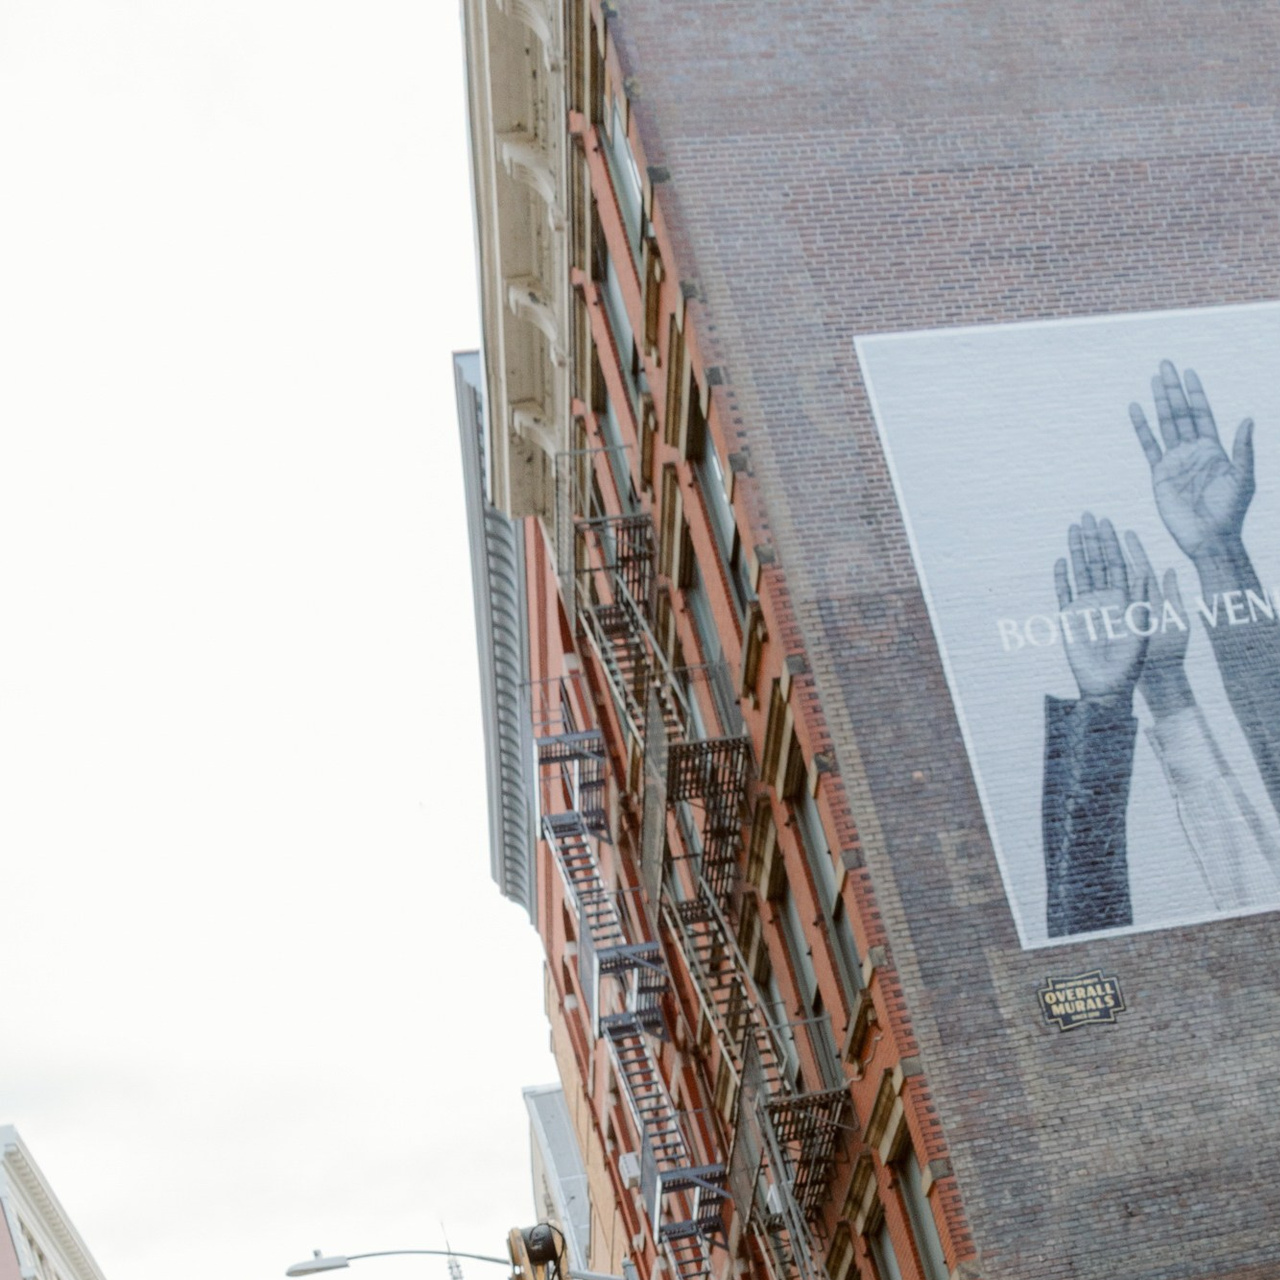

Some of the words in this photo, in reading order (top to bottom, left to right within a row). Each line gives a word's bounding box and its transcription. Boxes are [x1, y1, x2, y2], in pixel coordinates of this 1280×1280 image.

[997, 600, 1187, 652] BOTTEGA
[1044, 982, 1115, 1004] OVERALL
[1050, 995, 1115, 1016] MURALS
